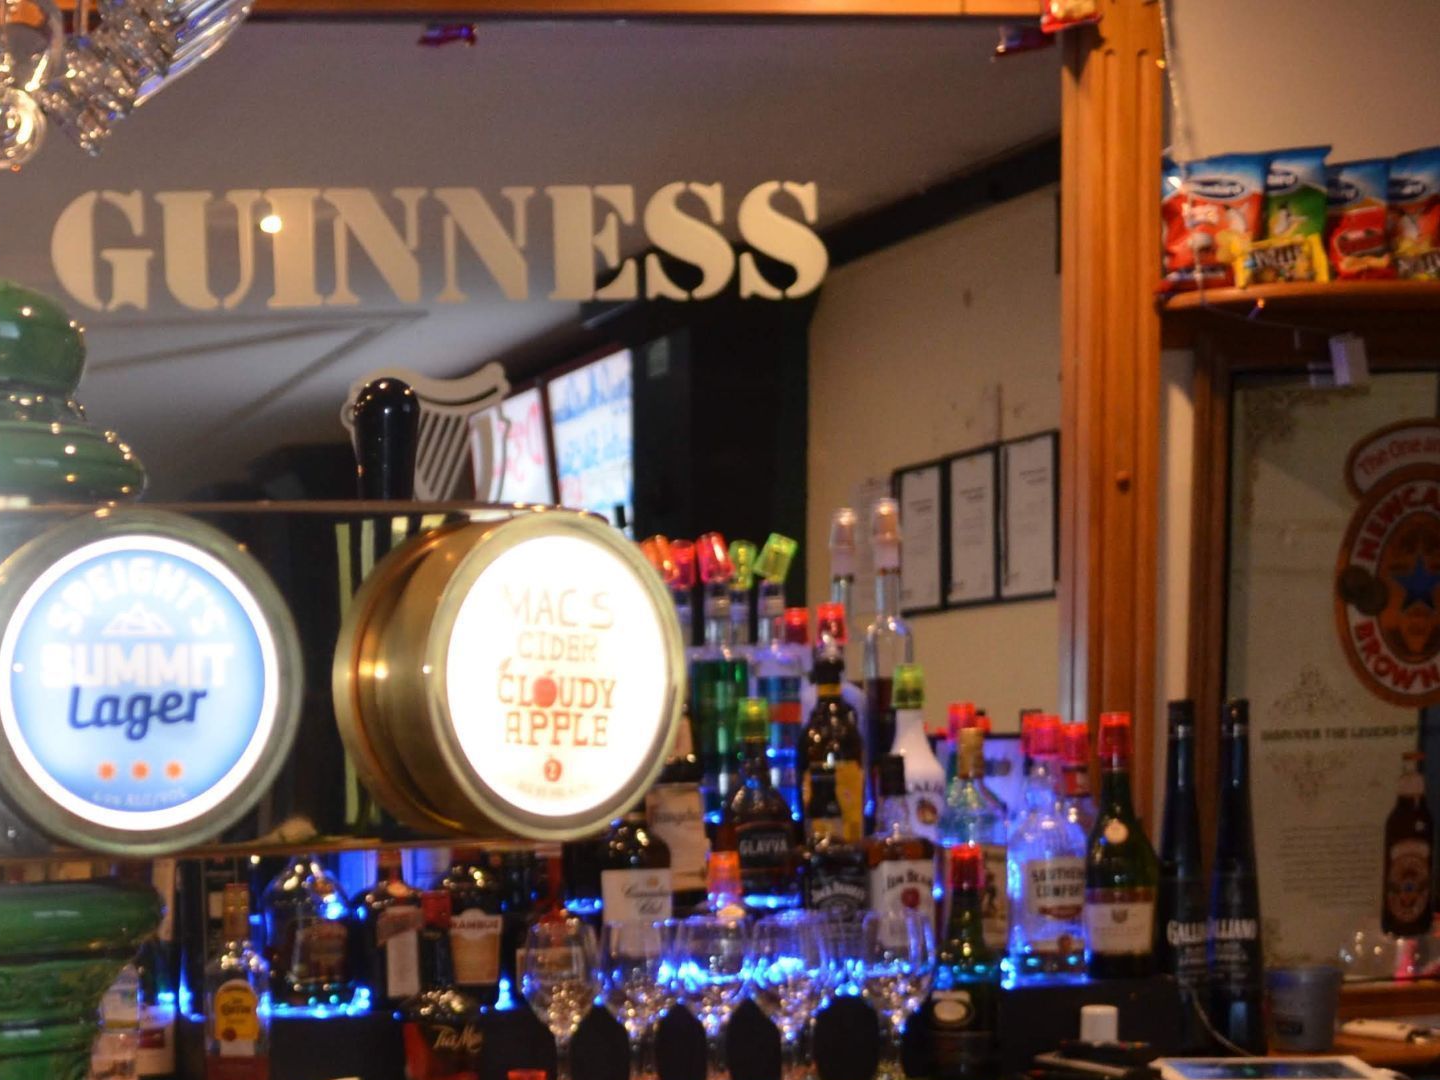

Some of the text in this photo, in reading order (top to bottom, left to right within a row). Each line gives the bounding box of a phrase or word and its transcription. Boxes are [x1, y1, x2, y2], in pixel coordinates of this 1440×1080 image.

[50, 179, 828, 312] GUINNESS
[40, 642, 235, 689] SUMMIT
[516, 633, 599, 662] CIDER
[496, 670, 617, 710] CLOUDY
[68, 684, 208, 742] Lager
[504, 711, 609, 747] APPLE
[738, 839, 789, 855] GLAYVA
